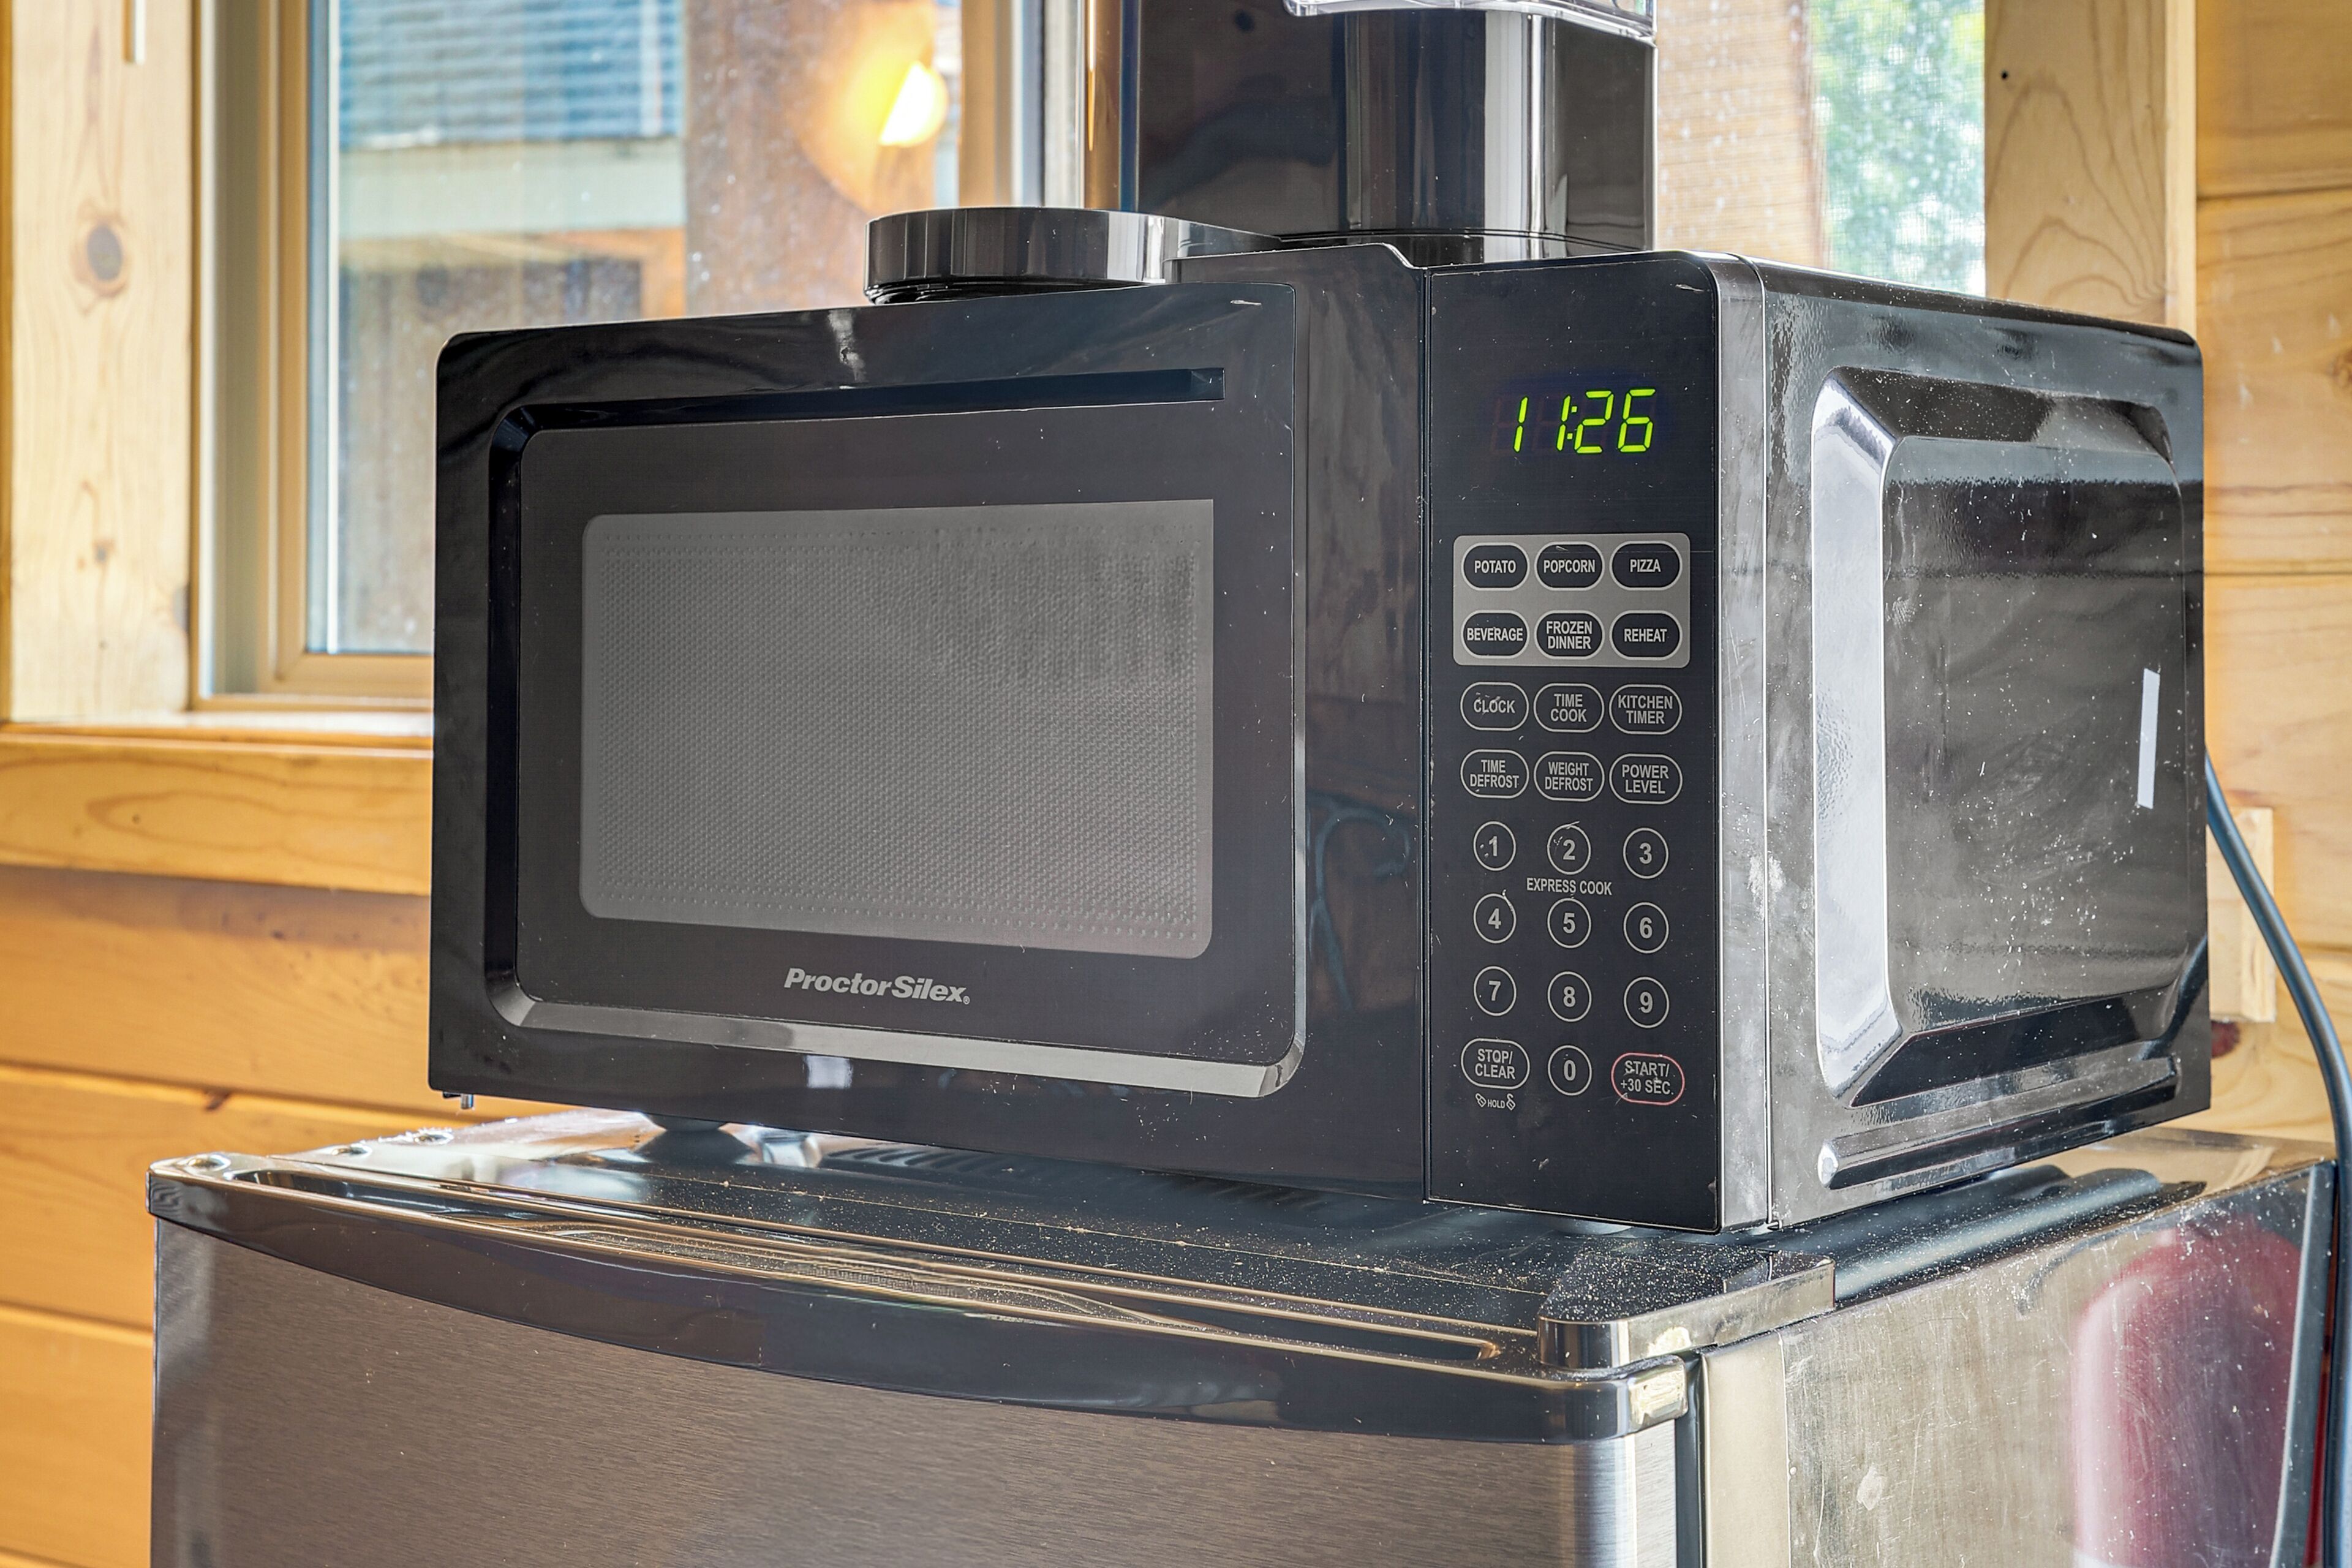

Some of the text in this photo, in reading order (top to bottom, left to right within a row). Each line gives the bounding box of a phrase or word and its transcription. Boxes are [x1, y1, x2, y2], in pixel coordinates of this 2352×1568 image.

[1514, 389, 1656, 454] 11:26
[1474, 559, 1516, 573] POTATO
[1544, 559, 1595, 573] POPCORN
[1630, 559, 1661, 572] PIZZA
[1467, 628, 1523, 641] BEVERAGE
[1546, 621, 1592, 634] FROZEN
[1547, 636, 1591, 649] DINNER
[1624, 628, 1667, 643] REHEAT
[1474, 699, 1515, 714] CLOCK
[1554, 693, 1583, 707] TIME
[1618, 695, 1673, 709] KITCHEN
[1550, 708, 1586, 722] COOK
[1626, 710, 1665, 724] TIMER
[1480, 760, 1506, 773] TIME
[1548, 762, 1589, 776] WEIGHT
[1622, 764, 1668, 778] POWER
[1470, 774, 1520, 788] DEFROST
[1545, 777, 1593, 791] DEFROST
[1625, 780, 1665, 794] LEVEL
[1488, 836, 1498, 856] 1
[1563, 839, 1575, 861] 2
[1639, 842, 1652, 864] 3
[1526, 878, 1613, 895] EXPRESS COOK
[1488, 908, 1501, 929] 4
[1563, 913, 1575, 933] 5
[1639, 917, 1653, 938] 6
[1488, 980, 1501, 1001] 7
[1563, 986, 1576, 1008] 8
[1640, 992, 1653, 1013] 9
[1477, 1049, 1513, 1063] STOP/
[1475, 1063, 1515, 1079] CLEAR
[1563, 1060, 1576, 1081] 0
[1624, 1060, 1669, 1077] START/
[1621, 1079, 1674, 1095] +30 SEC.
[1487, 1099, 1505, 1109] HOLD
